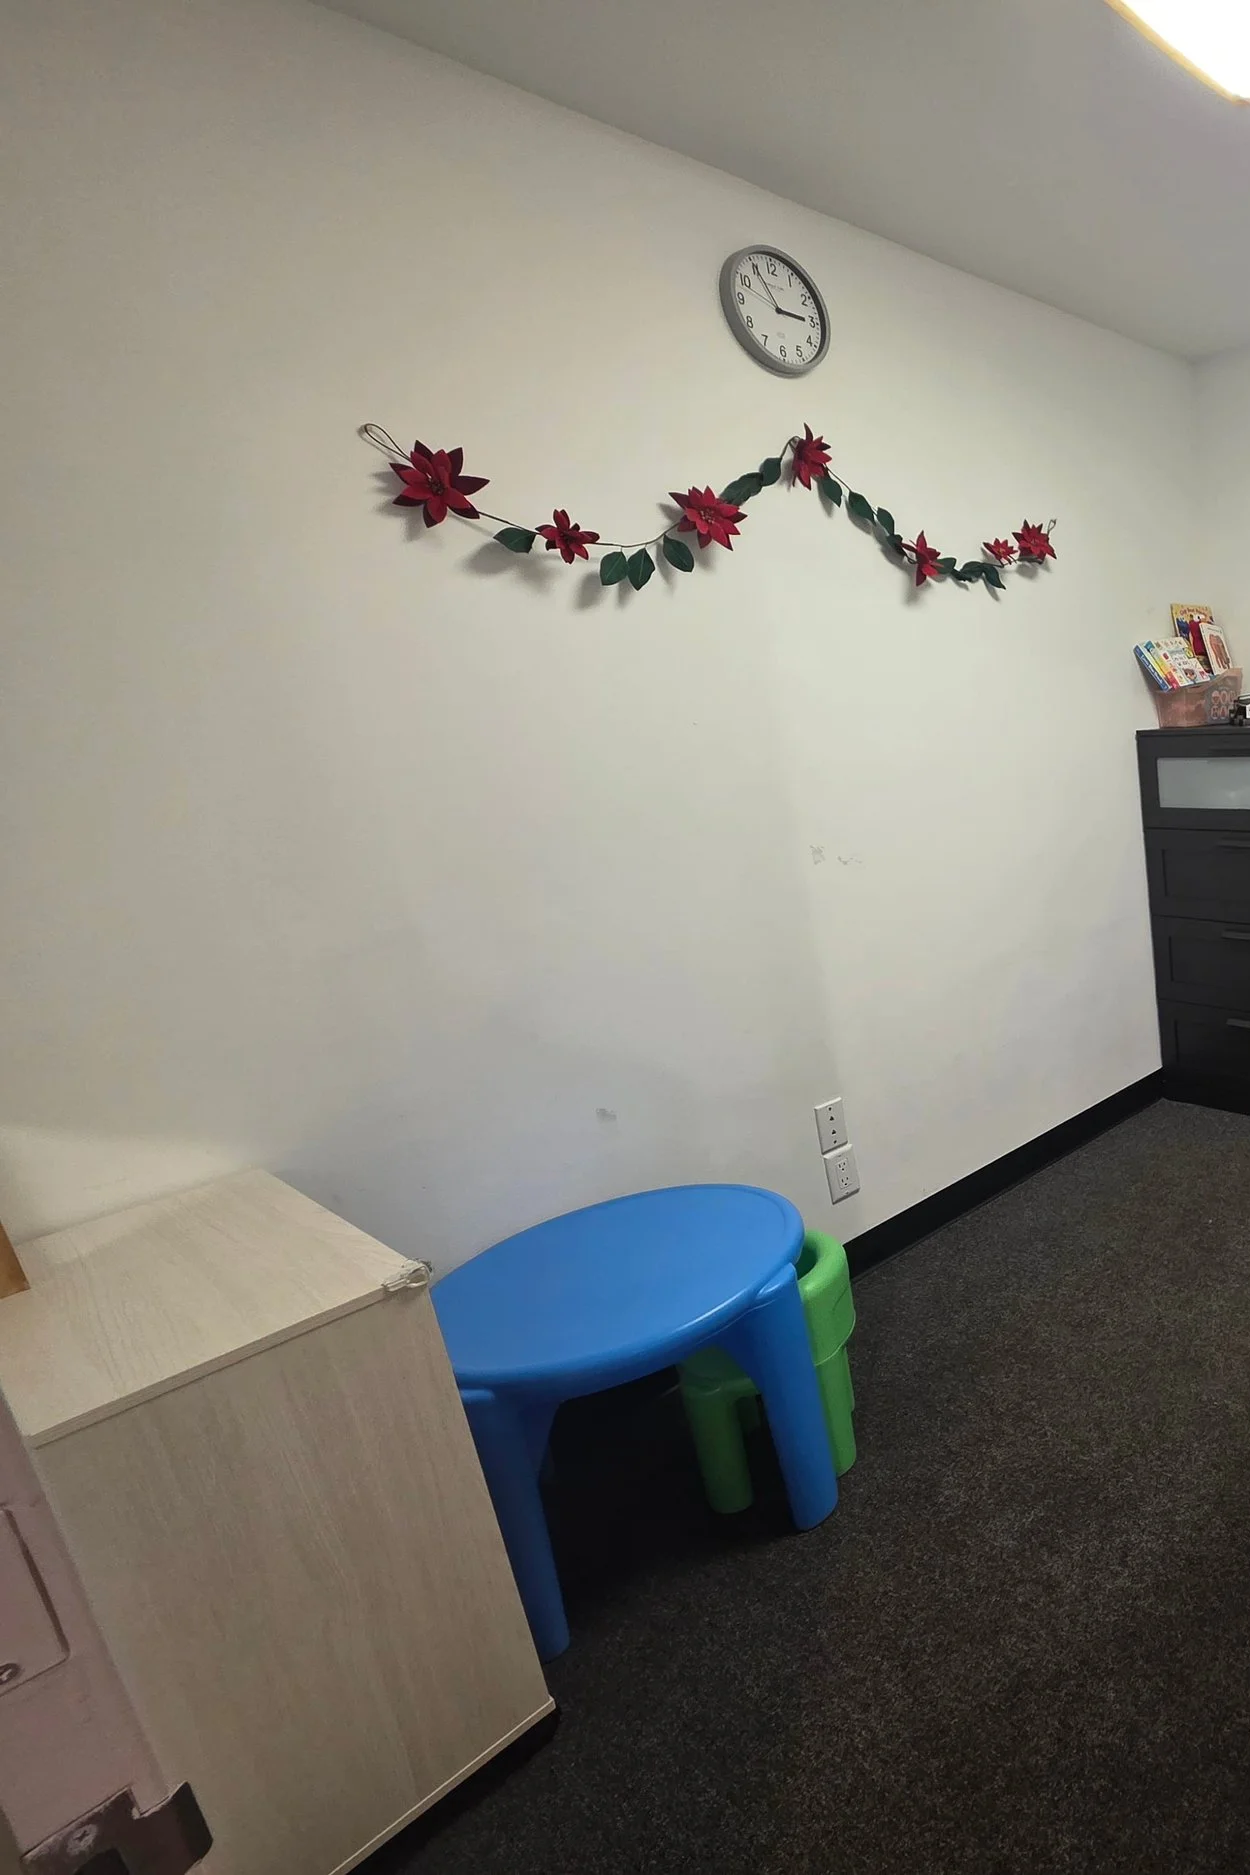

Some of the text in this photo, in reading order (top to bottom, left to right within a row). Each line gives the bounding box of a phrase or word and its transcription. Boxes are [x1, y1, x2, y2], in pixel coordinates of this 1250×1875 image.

[752, 262, 761, 276] 11
[766, 261, 778, 277] 12
[739, 272, 751, 289] 10
[788, 274, 792, 288] 1
[736, 291, 745, 305] 9
[800, 293, 808, 307] 2
[745, 315, 754, 329] 8
[808, 315, 816, 328] 3
[761, 333, 768, 346] 7
[806, 335, 813, 347] 4
[779, 345, 787, 358] 6
[795, 345, 803, 357] 5
